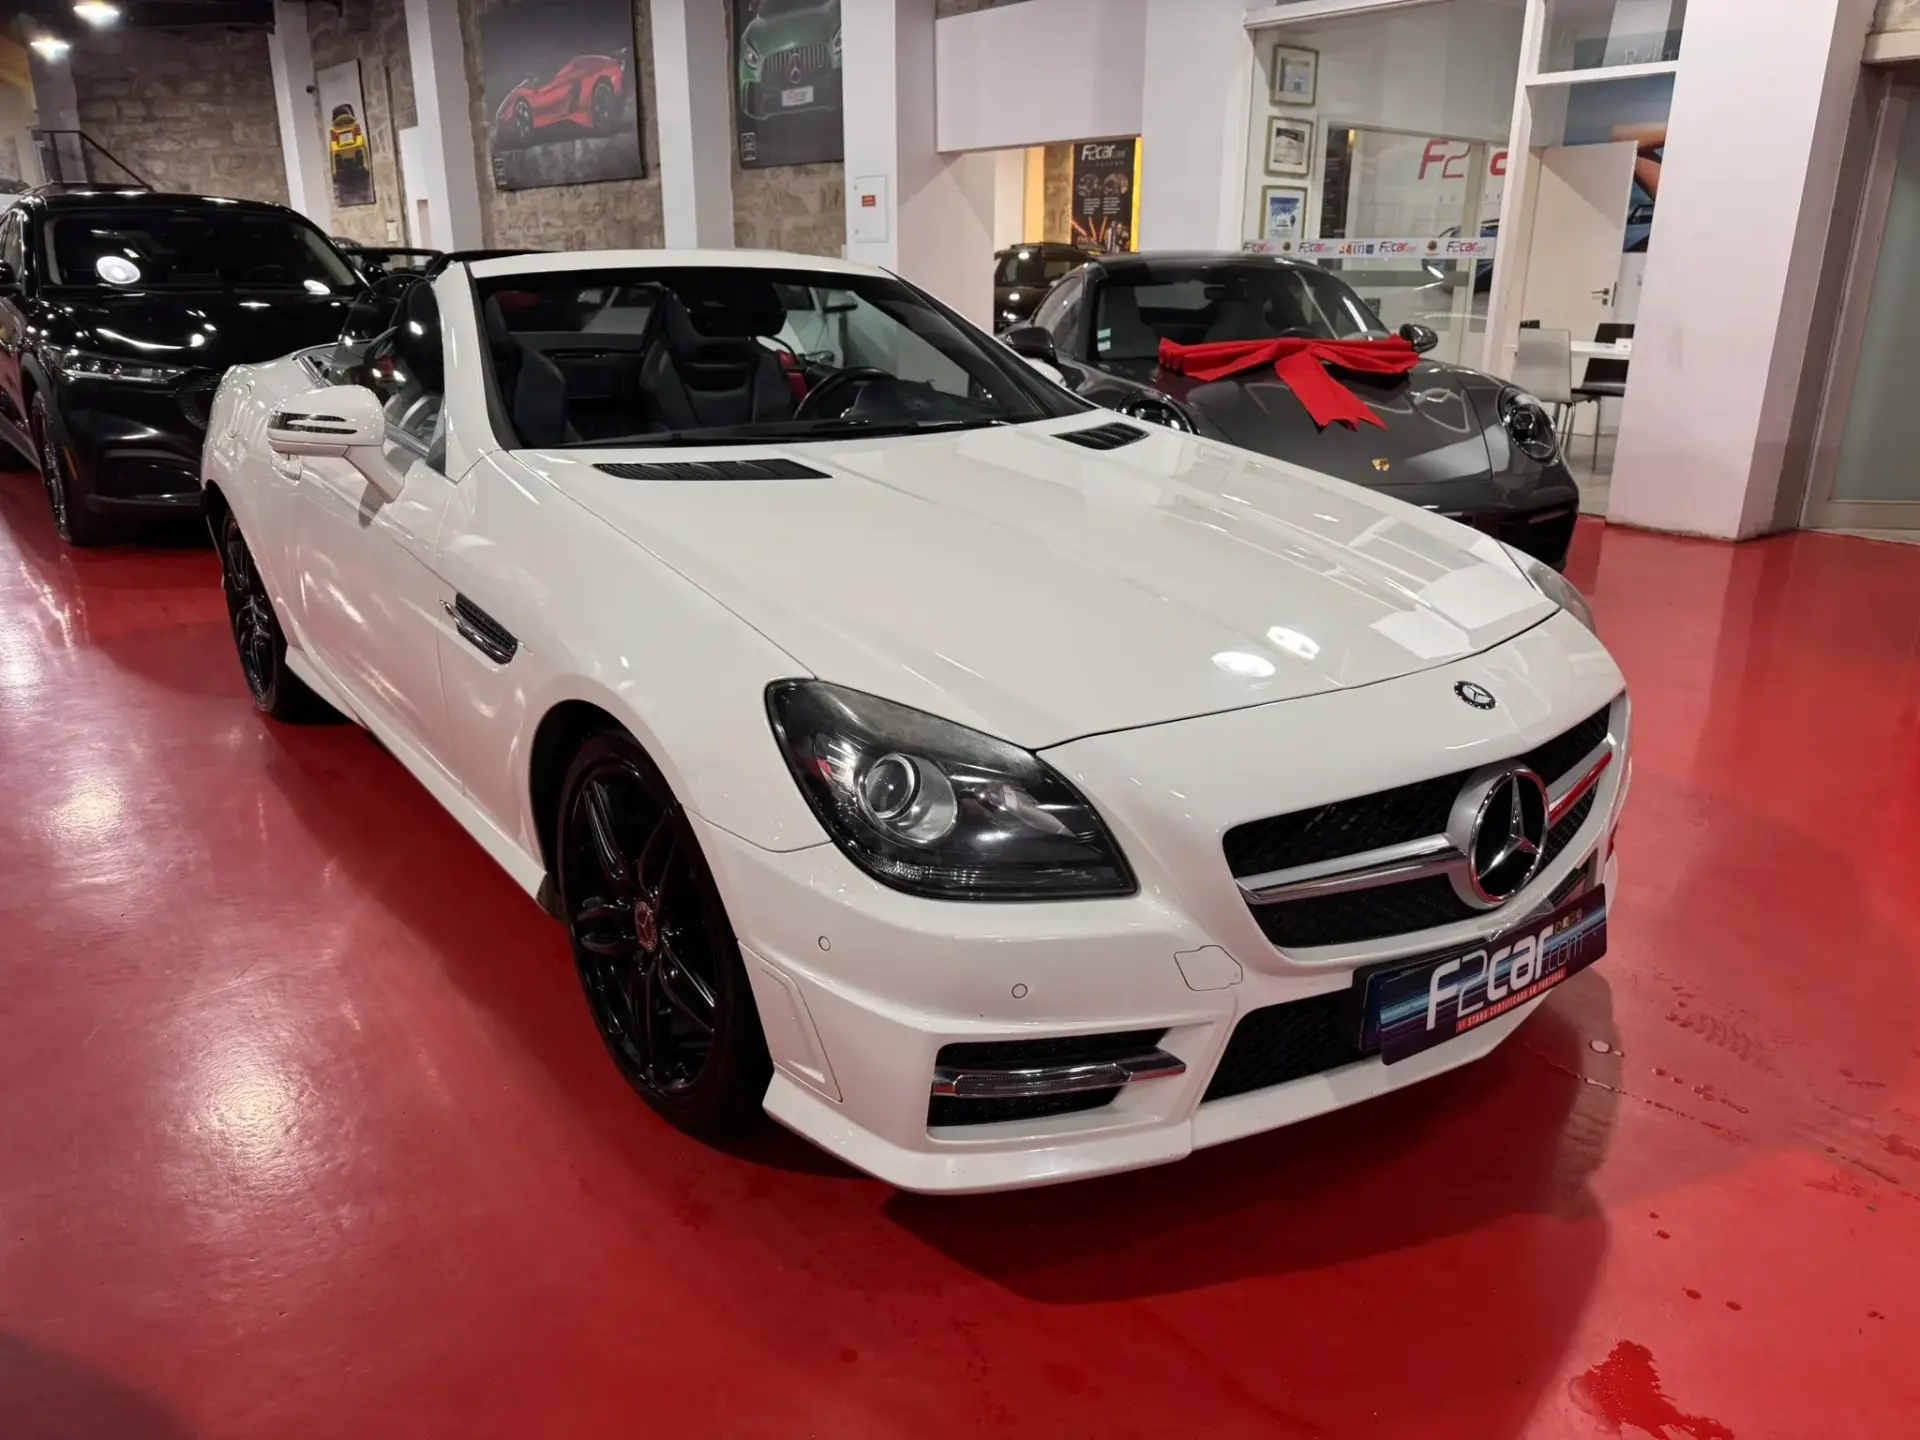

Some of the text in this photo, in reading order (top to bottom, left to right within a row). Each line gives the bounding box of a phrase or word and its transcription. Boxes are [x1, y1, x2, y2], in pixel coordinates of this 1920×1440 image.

[1467, 1009, 1489, 1027] STAND
[1490, 992, 1528, 1016] CERTIFICADO
[1538, 968, 1565, 991] PORTUGAL
